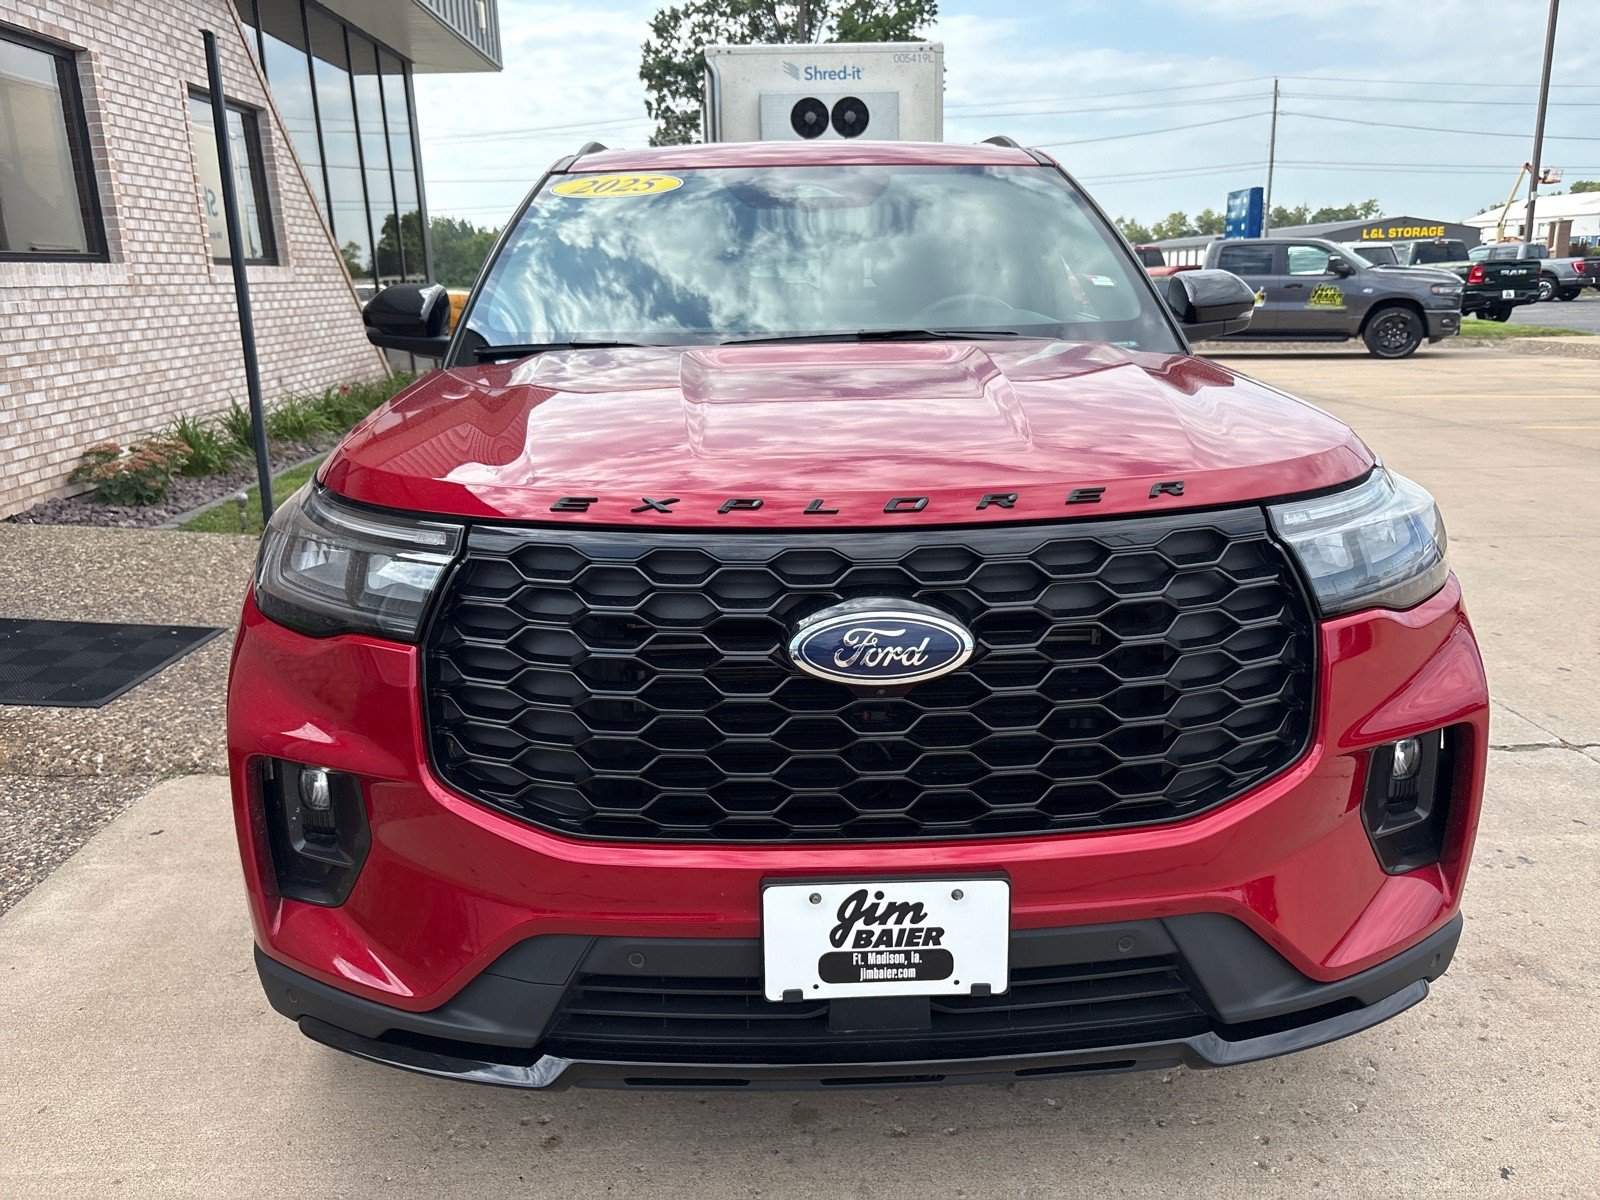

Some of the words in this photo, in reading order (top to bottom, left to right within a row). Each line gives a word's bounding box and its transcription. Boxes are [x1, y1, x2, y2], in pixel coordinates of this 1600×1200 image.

[804, 65, 862, 81] Shred-it
[570, 178, 663, 195] 2025
[1362, 228, 1385, 239] L&L
[1388, 226, 1445, 238] STORAGE
[550, 480, 1186, 514] EXPLORER
[833, 627, 931, 668] Ford
[829, 888, 928, 949] Jim
[851, 926, 945, 949] BAIER
[852, 952, 865, 965] Ft.
[867, 952, 908, 965] Madison,
[911, 950, 923, 964] Ia.
[860, 966, 917, 982] jimbaier.com
